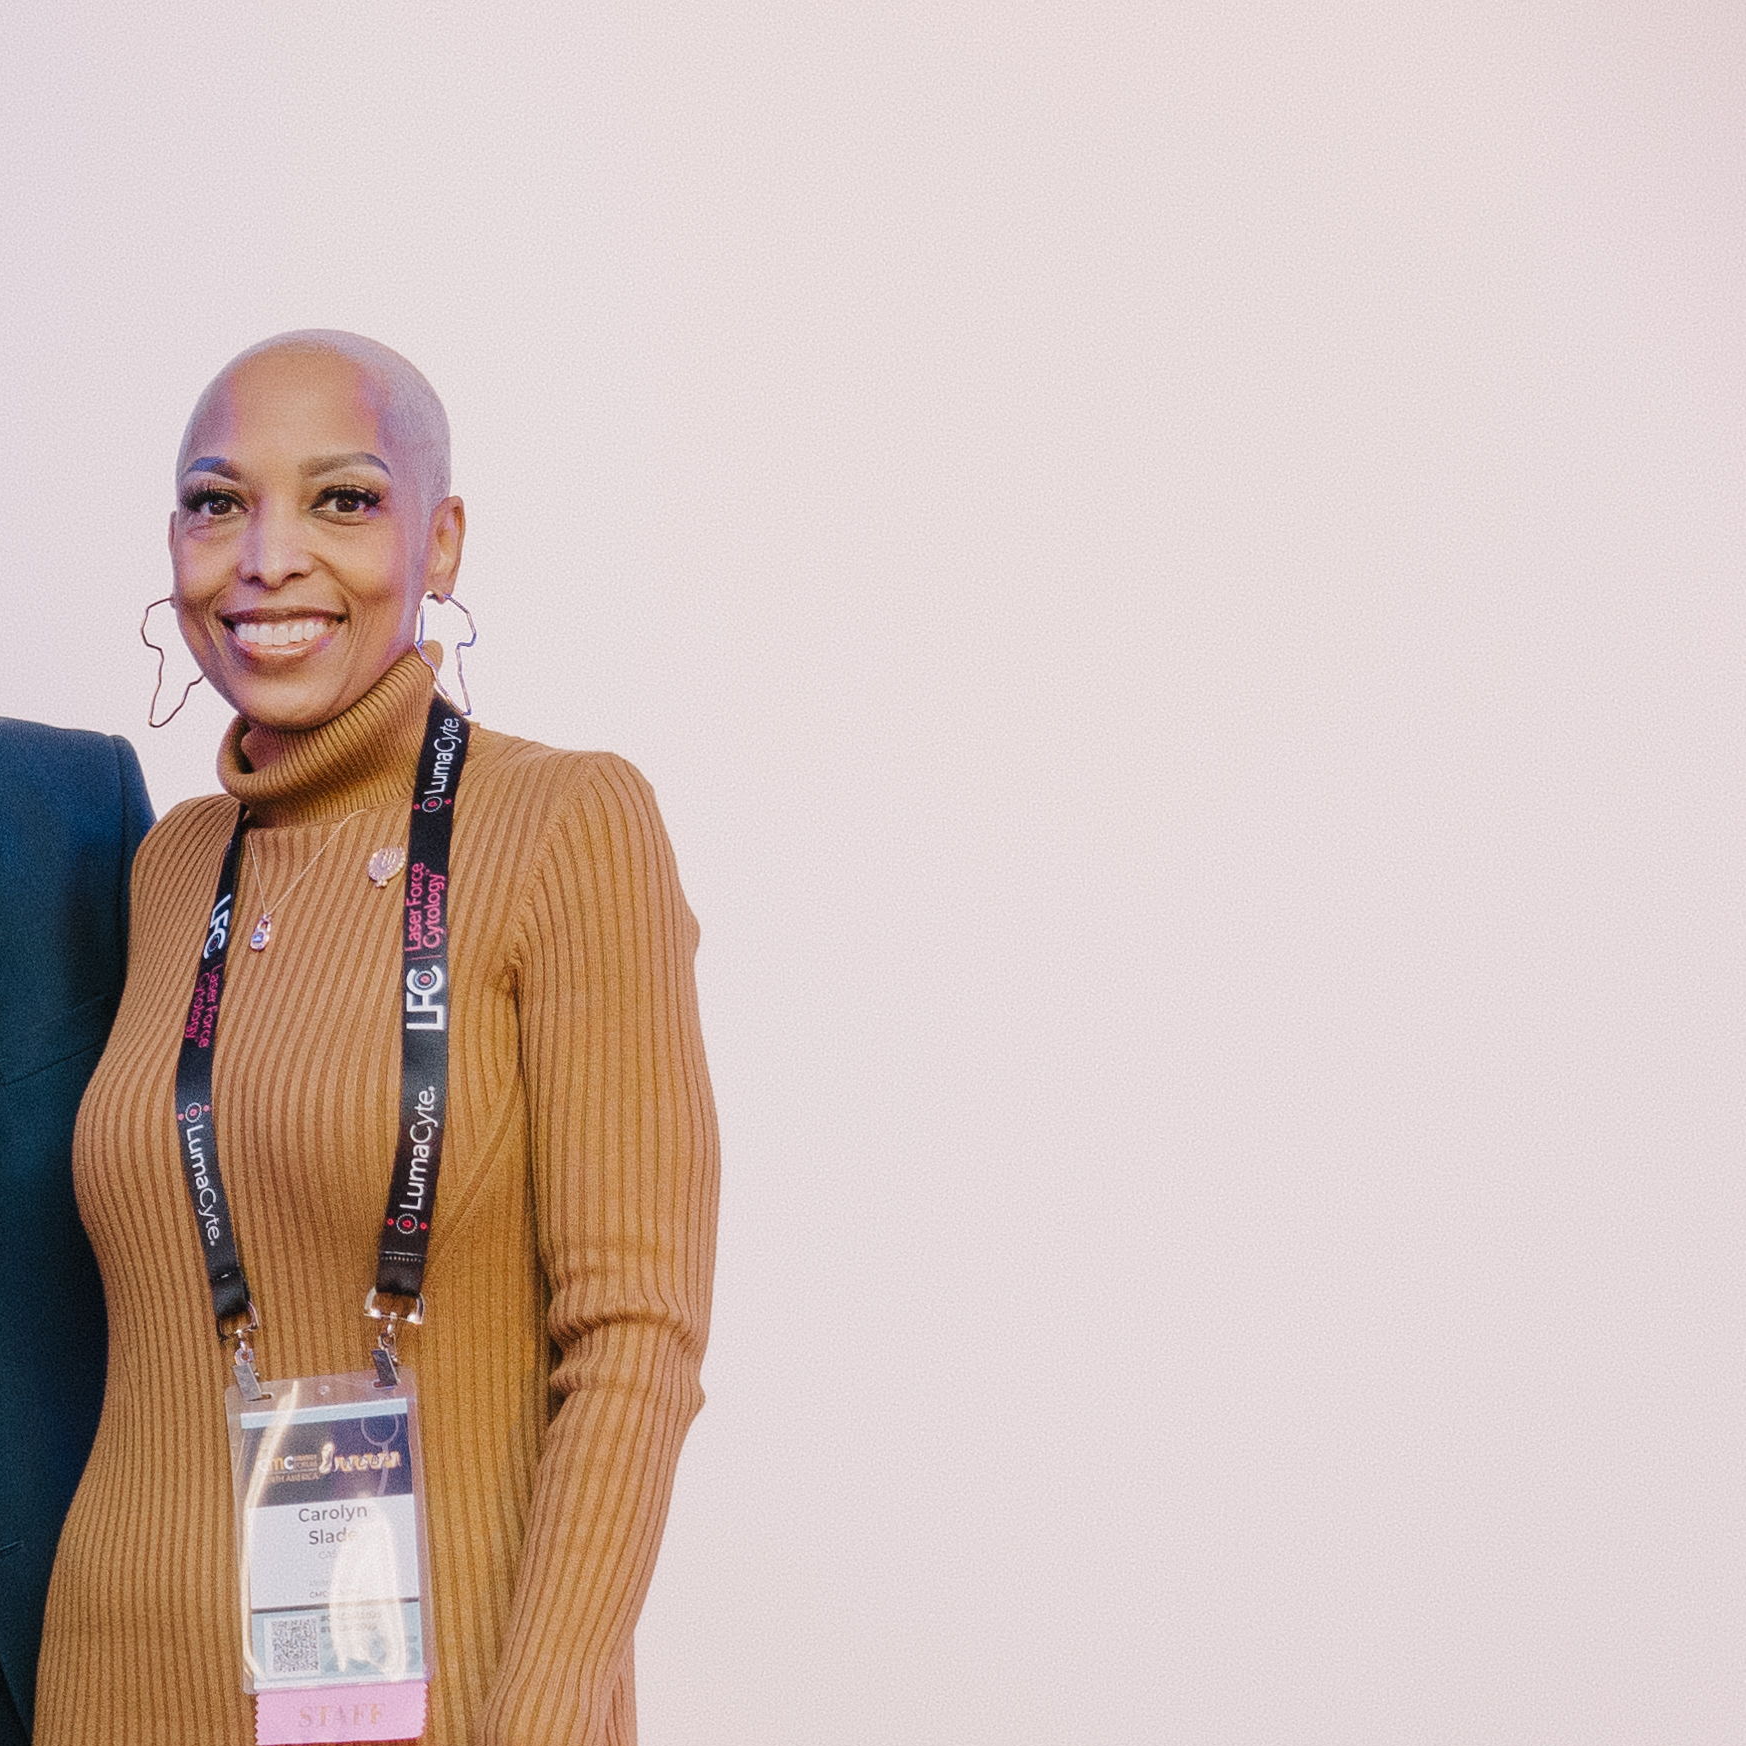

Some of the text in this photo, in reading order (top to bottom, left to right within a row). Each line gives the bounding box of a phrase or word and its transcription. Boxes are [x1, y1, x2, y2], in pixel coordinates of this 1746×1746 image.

[405, 862, 424, 951] Laser Force
[423, 874, 446, 948] Cytology
[185, 972, 209, 1039] Cytology
[199, 963, 224, 1048] Laser Force
[406, 965, 444, 1031] LFC
[299, 1504, 367, 1522] Carolyn
[299, 1703, 386, 1727] STAFF
